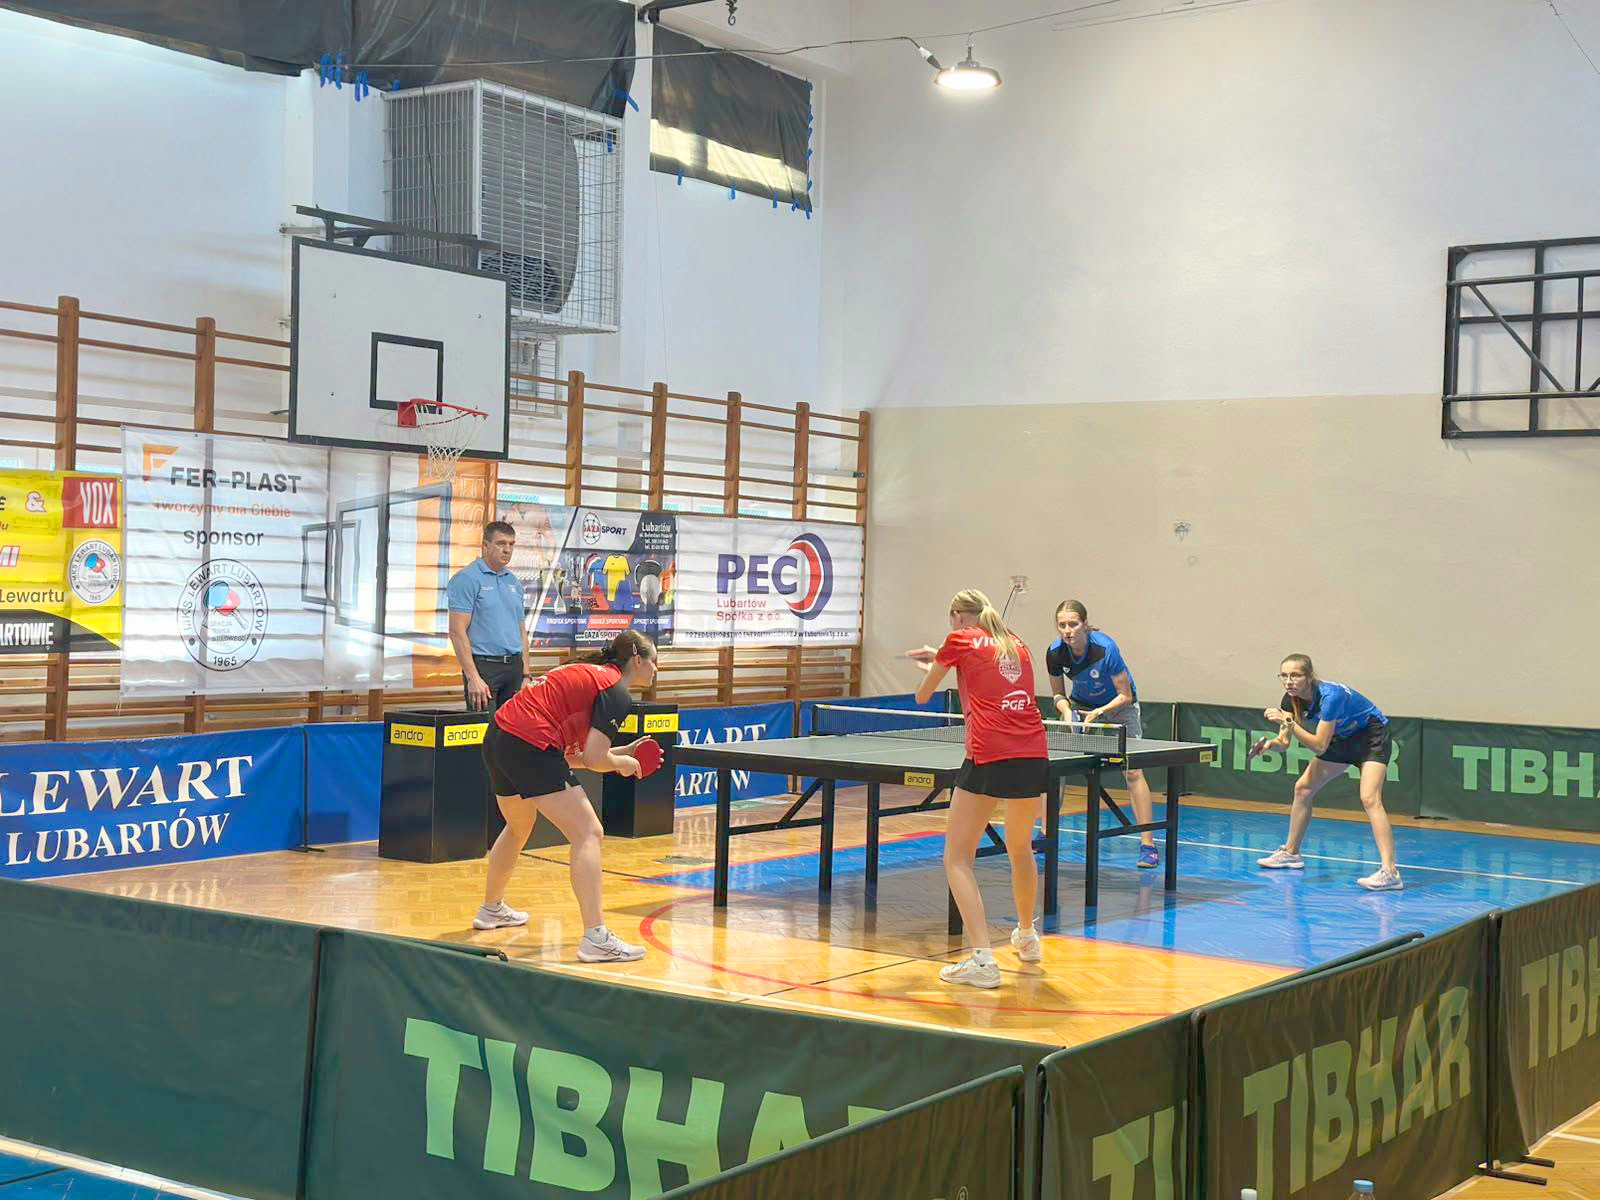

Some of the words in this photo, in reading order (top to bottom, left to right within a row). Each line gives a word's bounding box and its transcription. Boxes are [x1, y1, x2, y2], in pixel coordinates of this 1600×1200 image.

[171, 466, 302, 494] FER-PLAST
[80, 481, 114, 525] VOX
[154, 500, 224, 518] Tworzymy
[183, 529, 264, 549] sponsor
[601, 525, 628, 536] SPORT
[188, 563, 229, 598] LEWART
[716, 553, 798, 596] PEC
[758, 613, 763, 621] z
[213, 656, 237, 667] 1965
[1001, 699, 1026, 711] PGE
[646, 718, 671, 728] andro
[393, 729, 424, 741] andro
[447, 729, 478, 741] andro
[906, 775, 931, 784] andro
[1452, 744, 1600, 798] TIBH
[6, 808, 230, 866] LUBARTÓW
[1243, 986, 1472, 1200] TIBHAR
